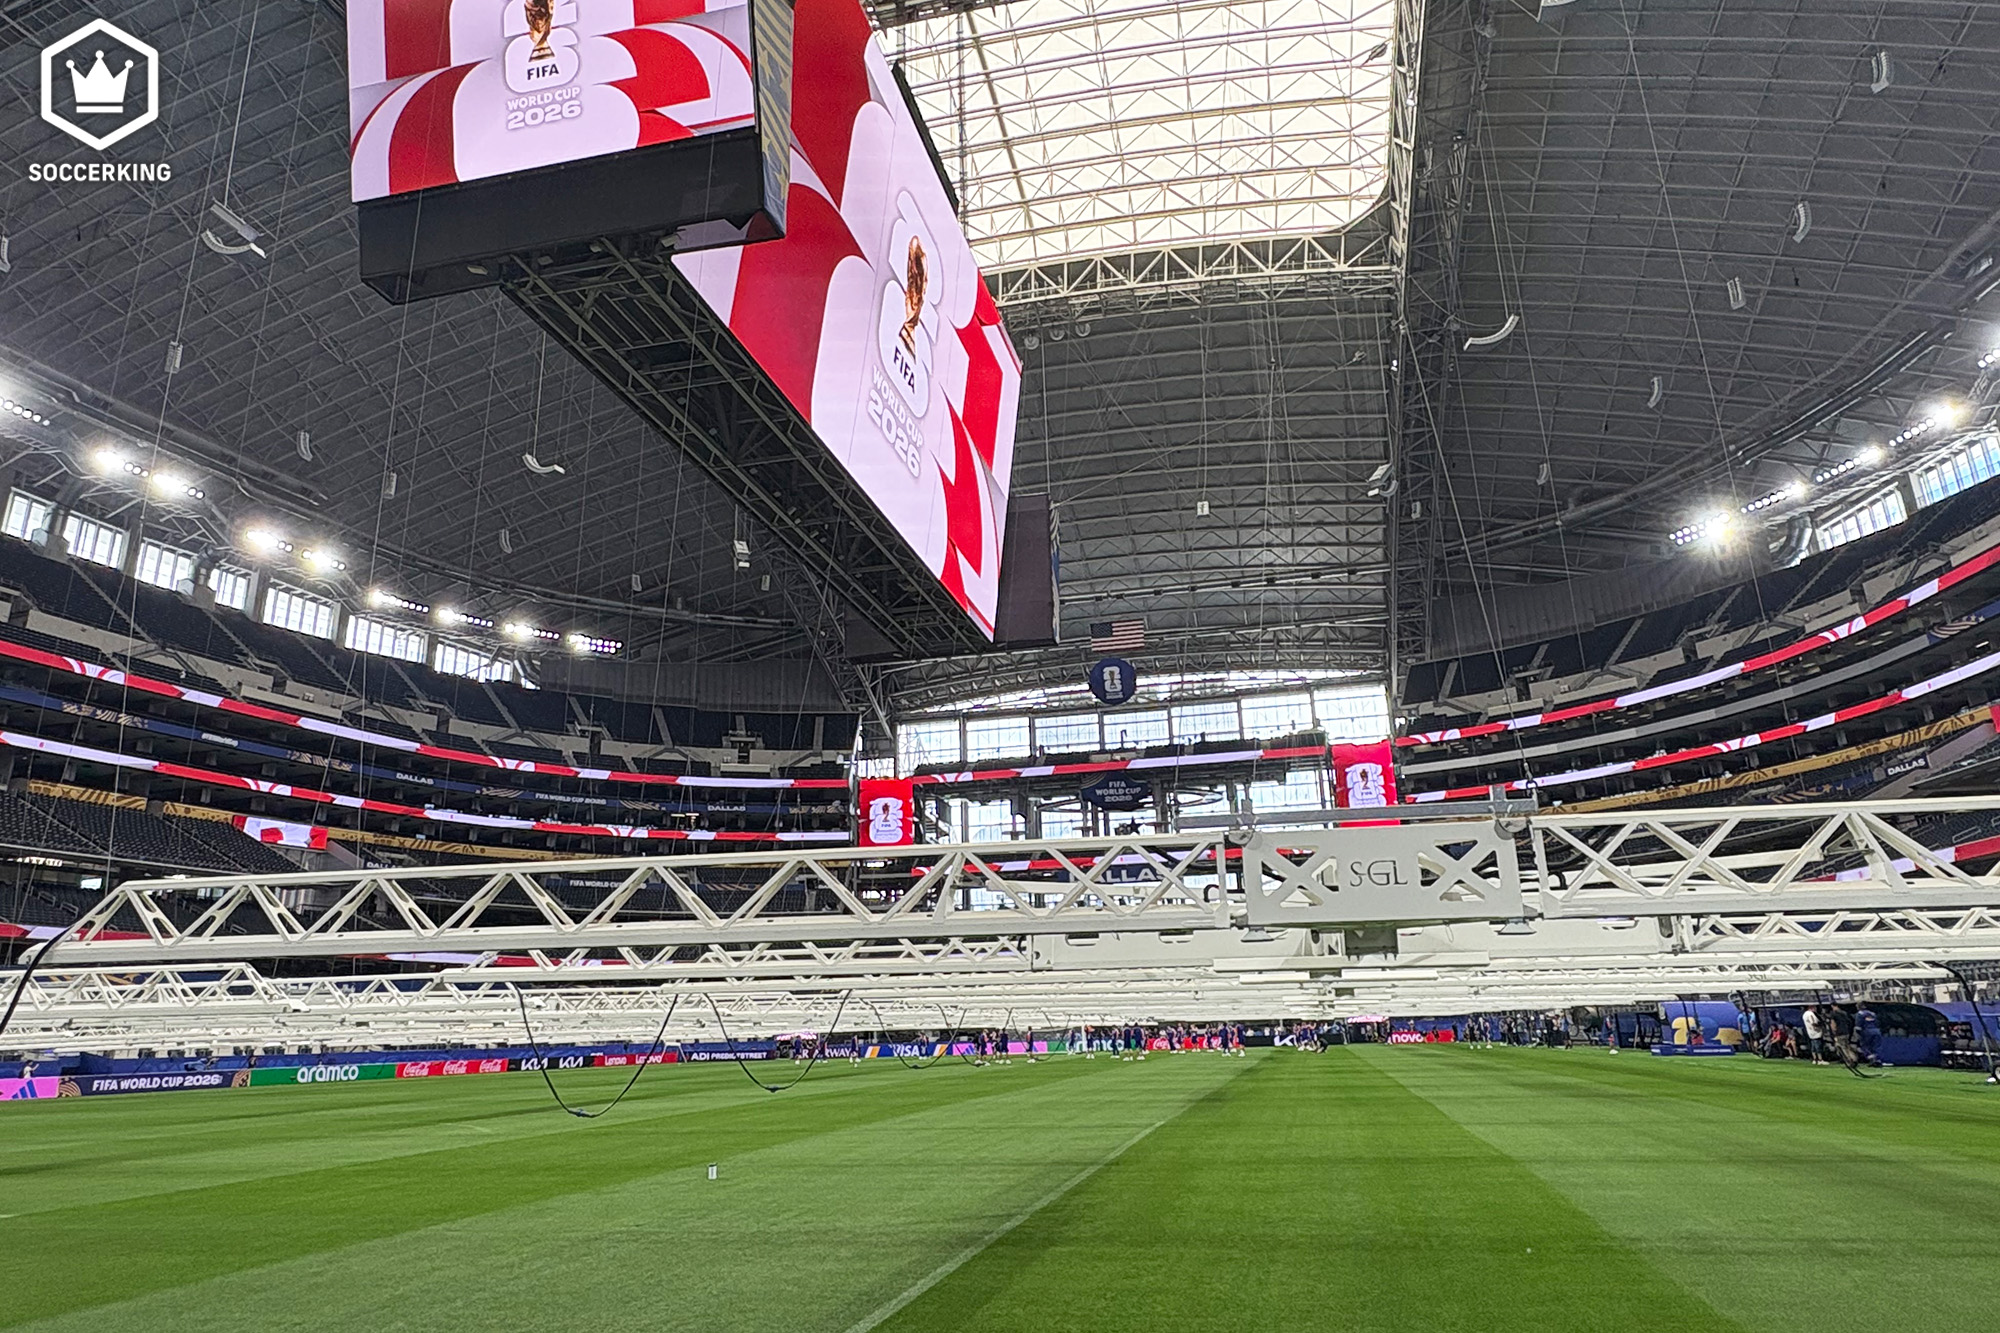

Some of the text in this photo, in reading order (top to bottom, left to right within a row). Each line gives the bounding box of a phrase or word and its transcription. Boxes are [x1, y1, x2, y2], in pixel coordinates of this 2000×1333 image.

[527, 63, 559, 80] FIFA
[507, 87, 580, 111] WORLD CUP
[507, 100, 581, 130] 2026
[893, 345, 915, 394] FIFA
[872, 365, 924, 448] WORLD CUP
[868, 389, 921, 478] 2026
[1886, 758, 1926, 776] DALLAS
[395, 772, 434, 785] DALLAS
[549, 794, 571, 802] WORLD
[1095, 788, 1124, 796] WORLD
[707, 804, 746, 812] DALLAS
[1349, 859, 1408, 888] SGL
[691, 1052, 709, 1060] ADI
[888, 1044, 920, 1057] VISA
[559, 1056, 583, 1069] KIA
[92, 1074, 221, 1092] FIFA WORLD CUP 2026
[297, 1065, 359, 1083] aramco
